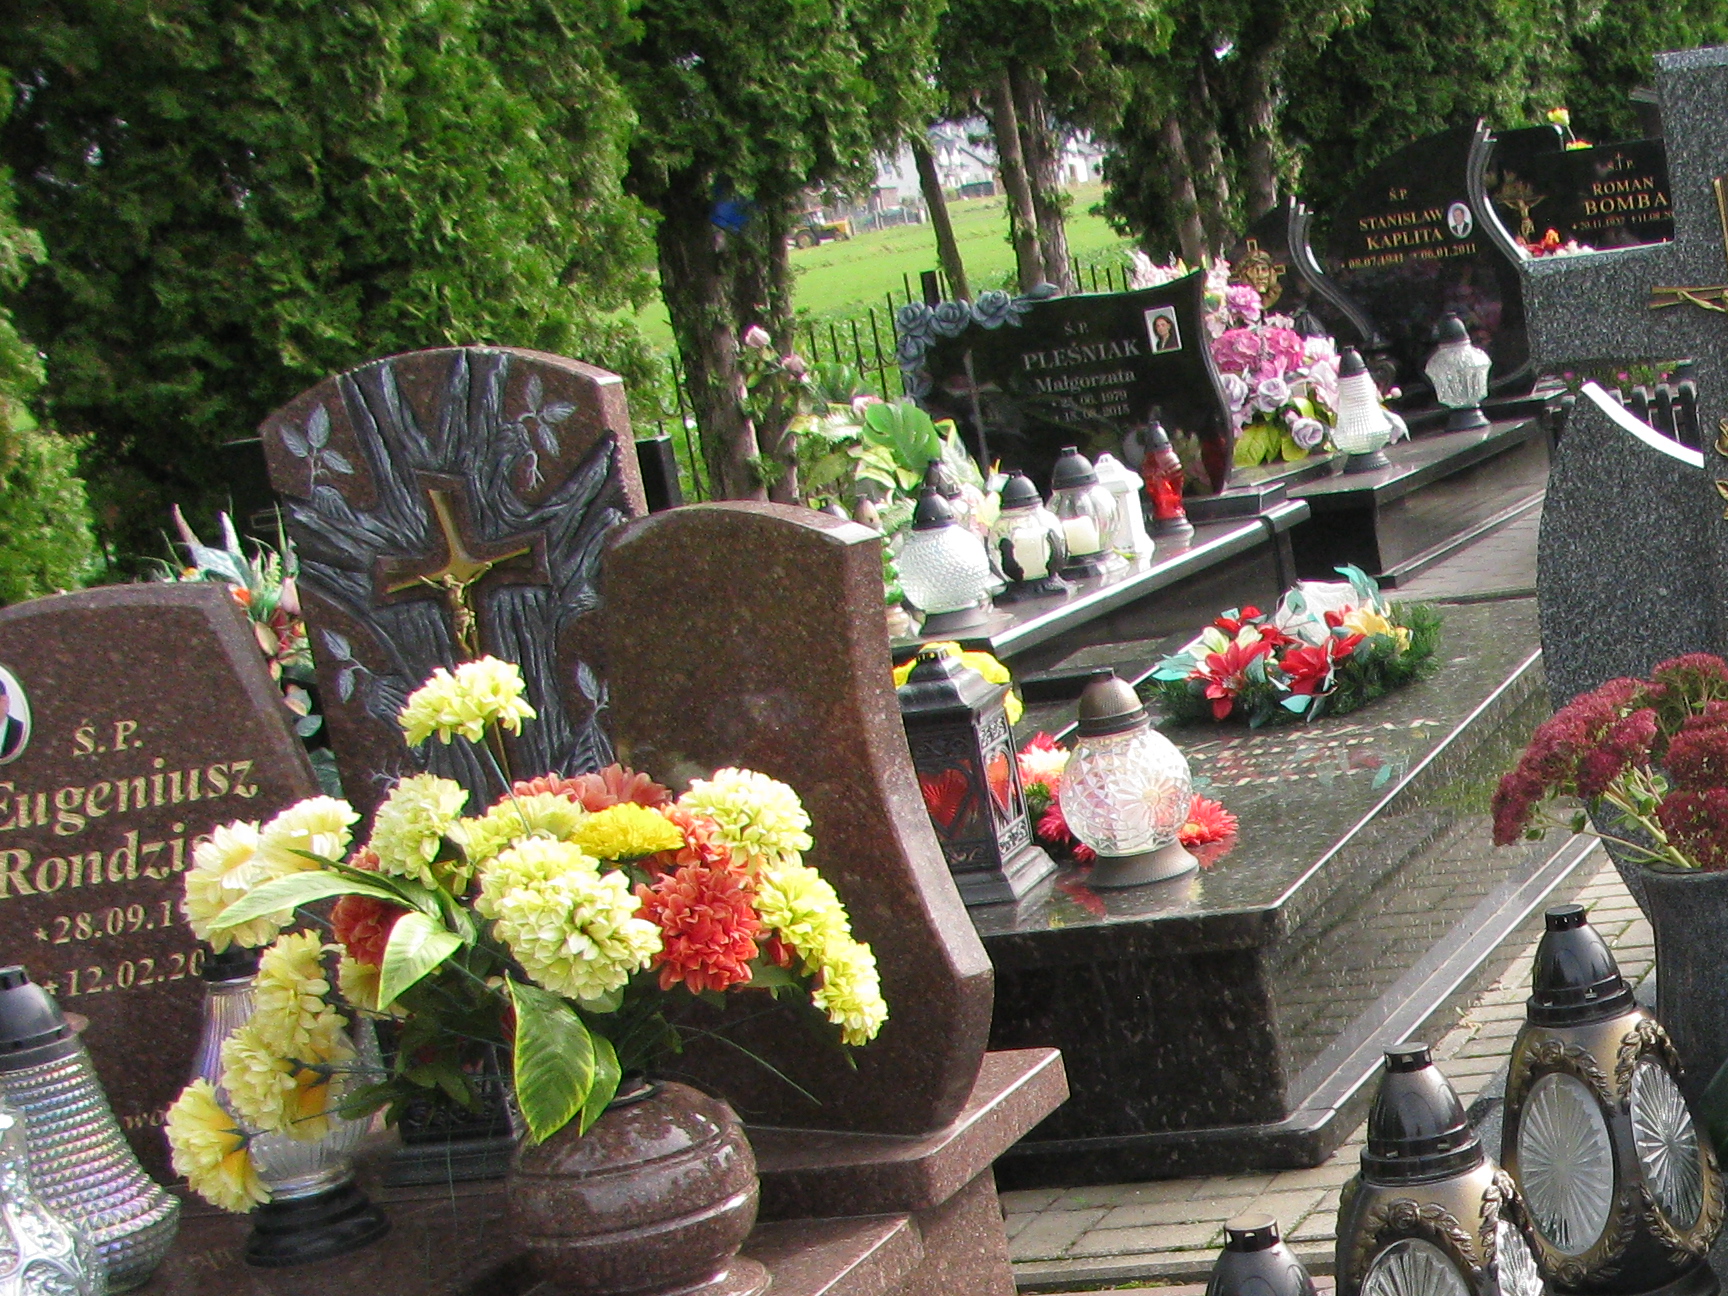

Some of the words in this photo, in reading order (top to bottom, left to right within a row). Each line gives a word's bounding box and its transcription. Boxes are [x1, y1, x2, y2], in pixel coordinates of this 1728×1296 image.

[1584, 191, 1668, 216] BOMBA
[1592, 176, 1655, 196] ROMAN
[1366, 227, 1444, 250] KAPLITA
[1022, 339, 1142, 371] PLEŚNIAK
[0, 757, 259, 836] Eugeniusz
[0, 822, 212, 899] Rondzi
[52, 900, 174, 945] 28.09.1
[66, 949, 207, 997] 12.02.20
